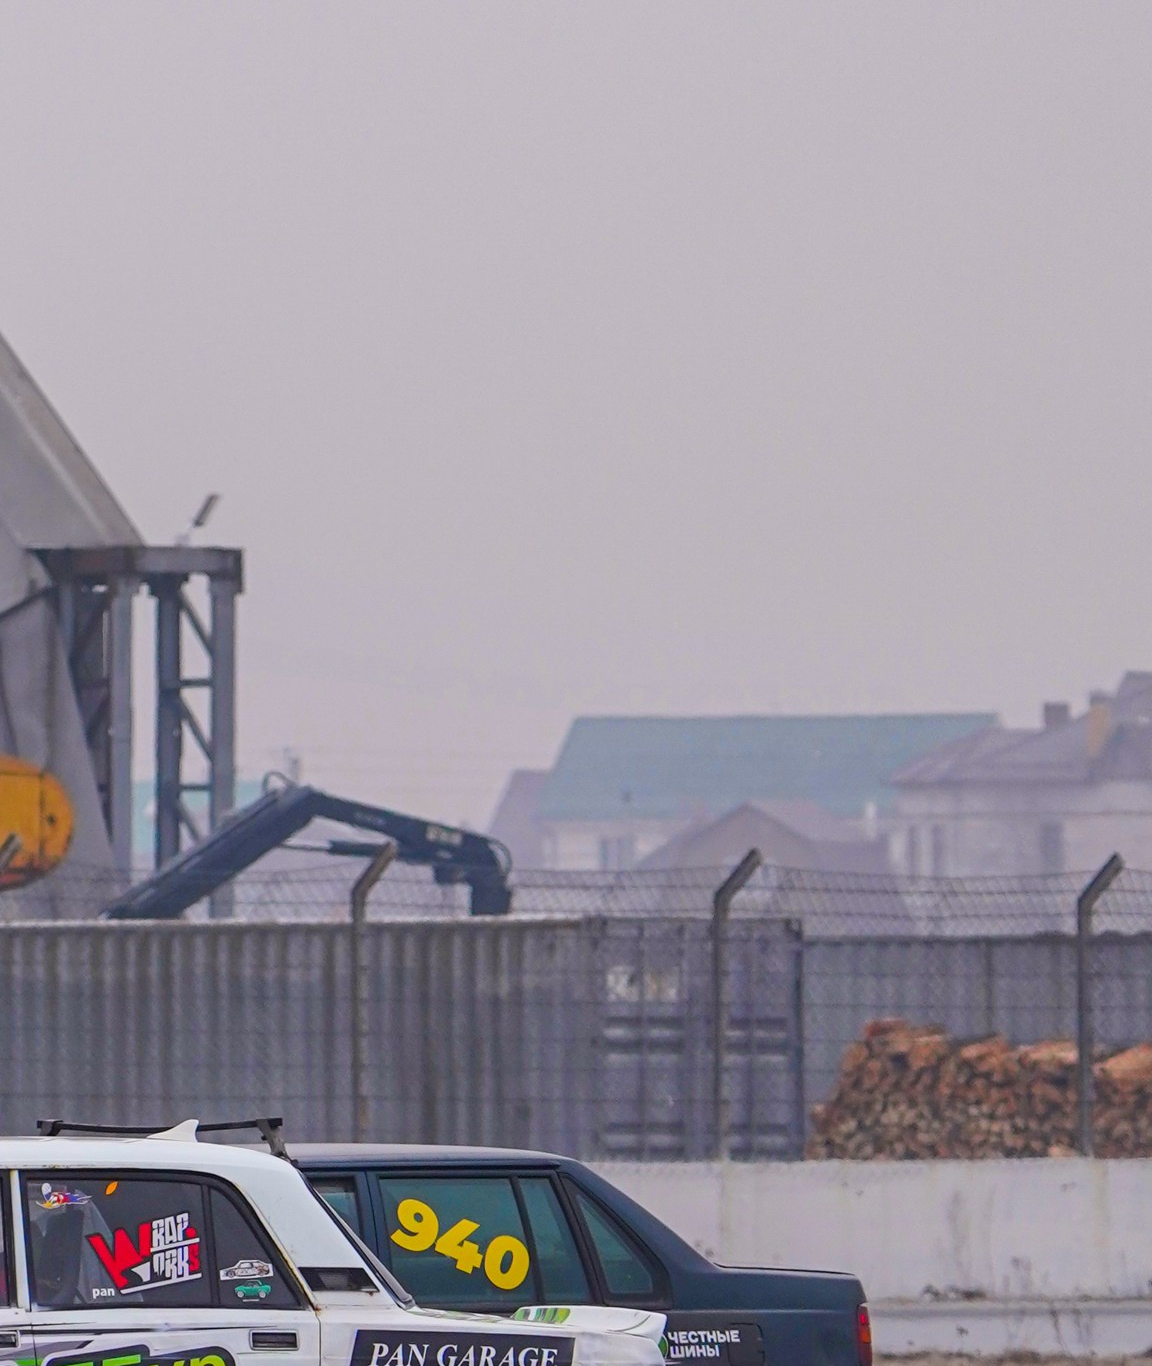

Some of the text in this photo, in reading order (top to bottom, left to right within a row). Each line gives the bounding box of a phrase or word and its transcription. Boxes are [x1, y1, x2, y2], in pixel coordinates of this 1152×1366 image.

[390, 1198, 530, 1290] 940
[92, 1287, 115, 1299] pan
[668, 1330, 741, 1344] ЧЕСТНЫЕ
[670, 1344, 720, 1358] ШИНЫ
